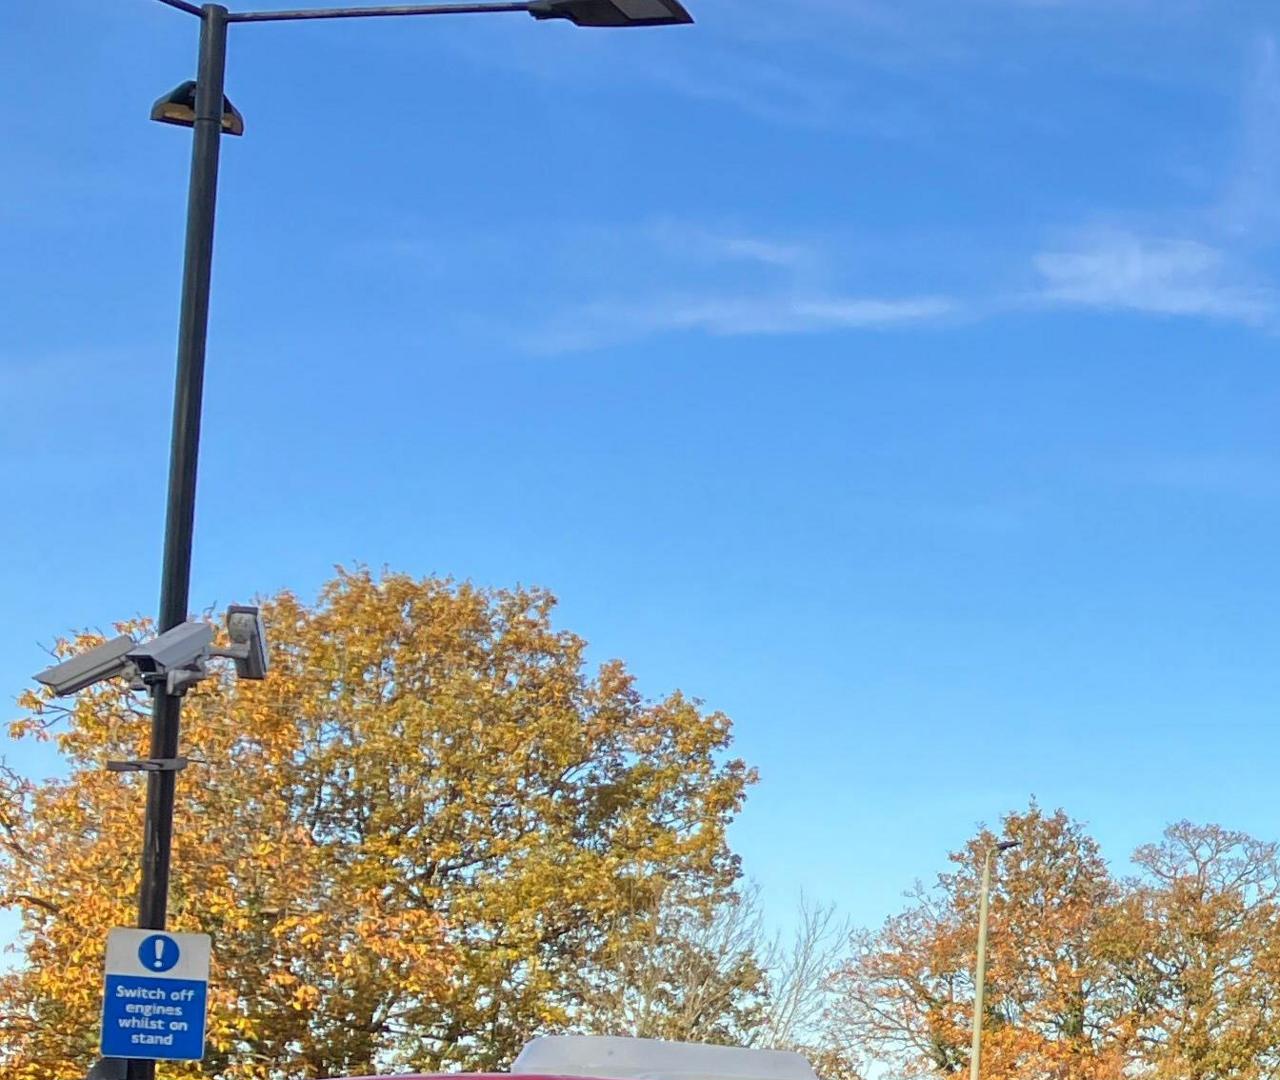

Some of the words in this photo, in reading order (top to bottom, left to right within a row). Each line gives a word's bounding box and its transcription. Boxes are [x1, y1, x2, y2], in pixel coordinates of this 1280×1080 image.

[116, 985, 166, 1000] Switch
[170, 989, 195, 1002] off
[126, 1002, 183, 1017] engines
[118, 1016, 165, 1030] whilst
[169, 1020, 188, 1031] on
[131, 1033, 174, 1046] stand
